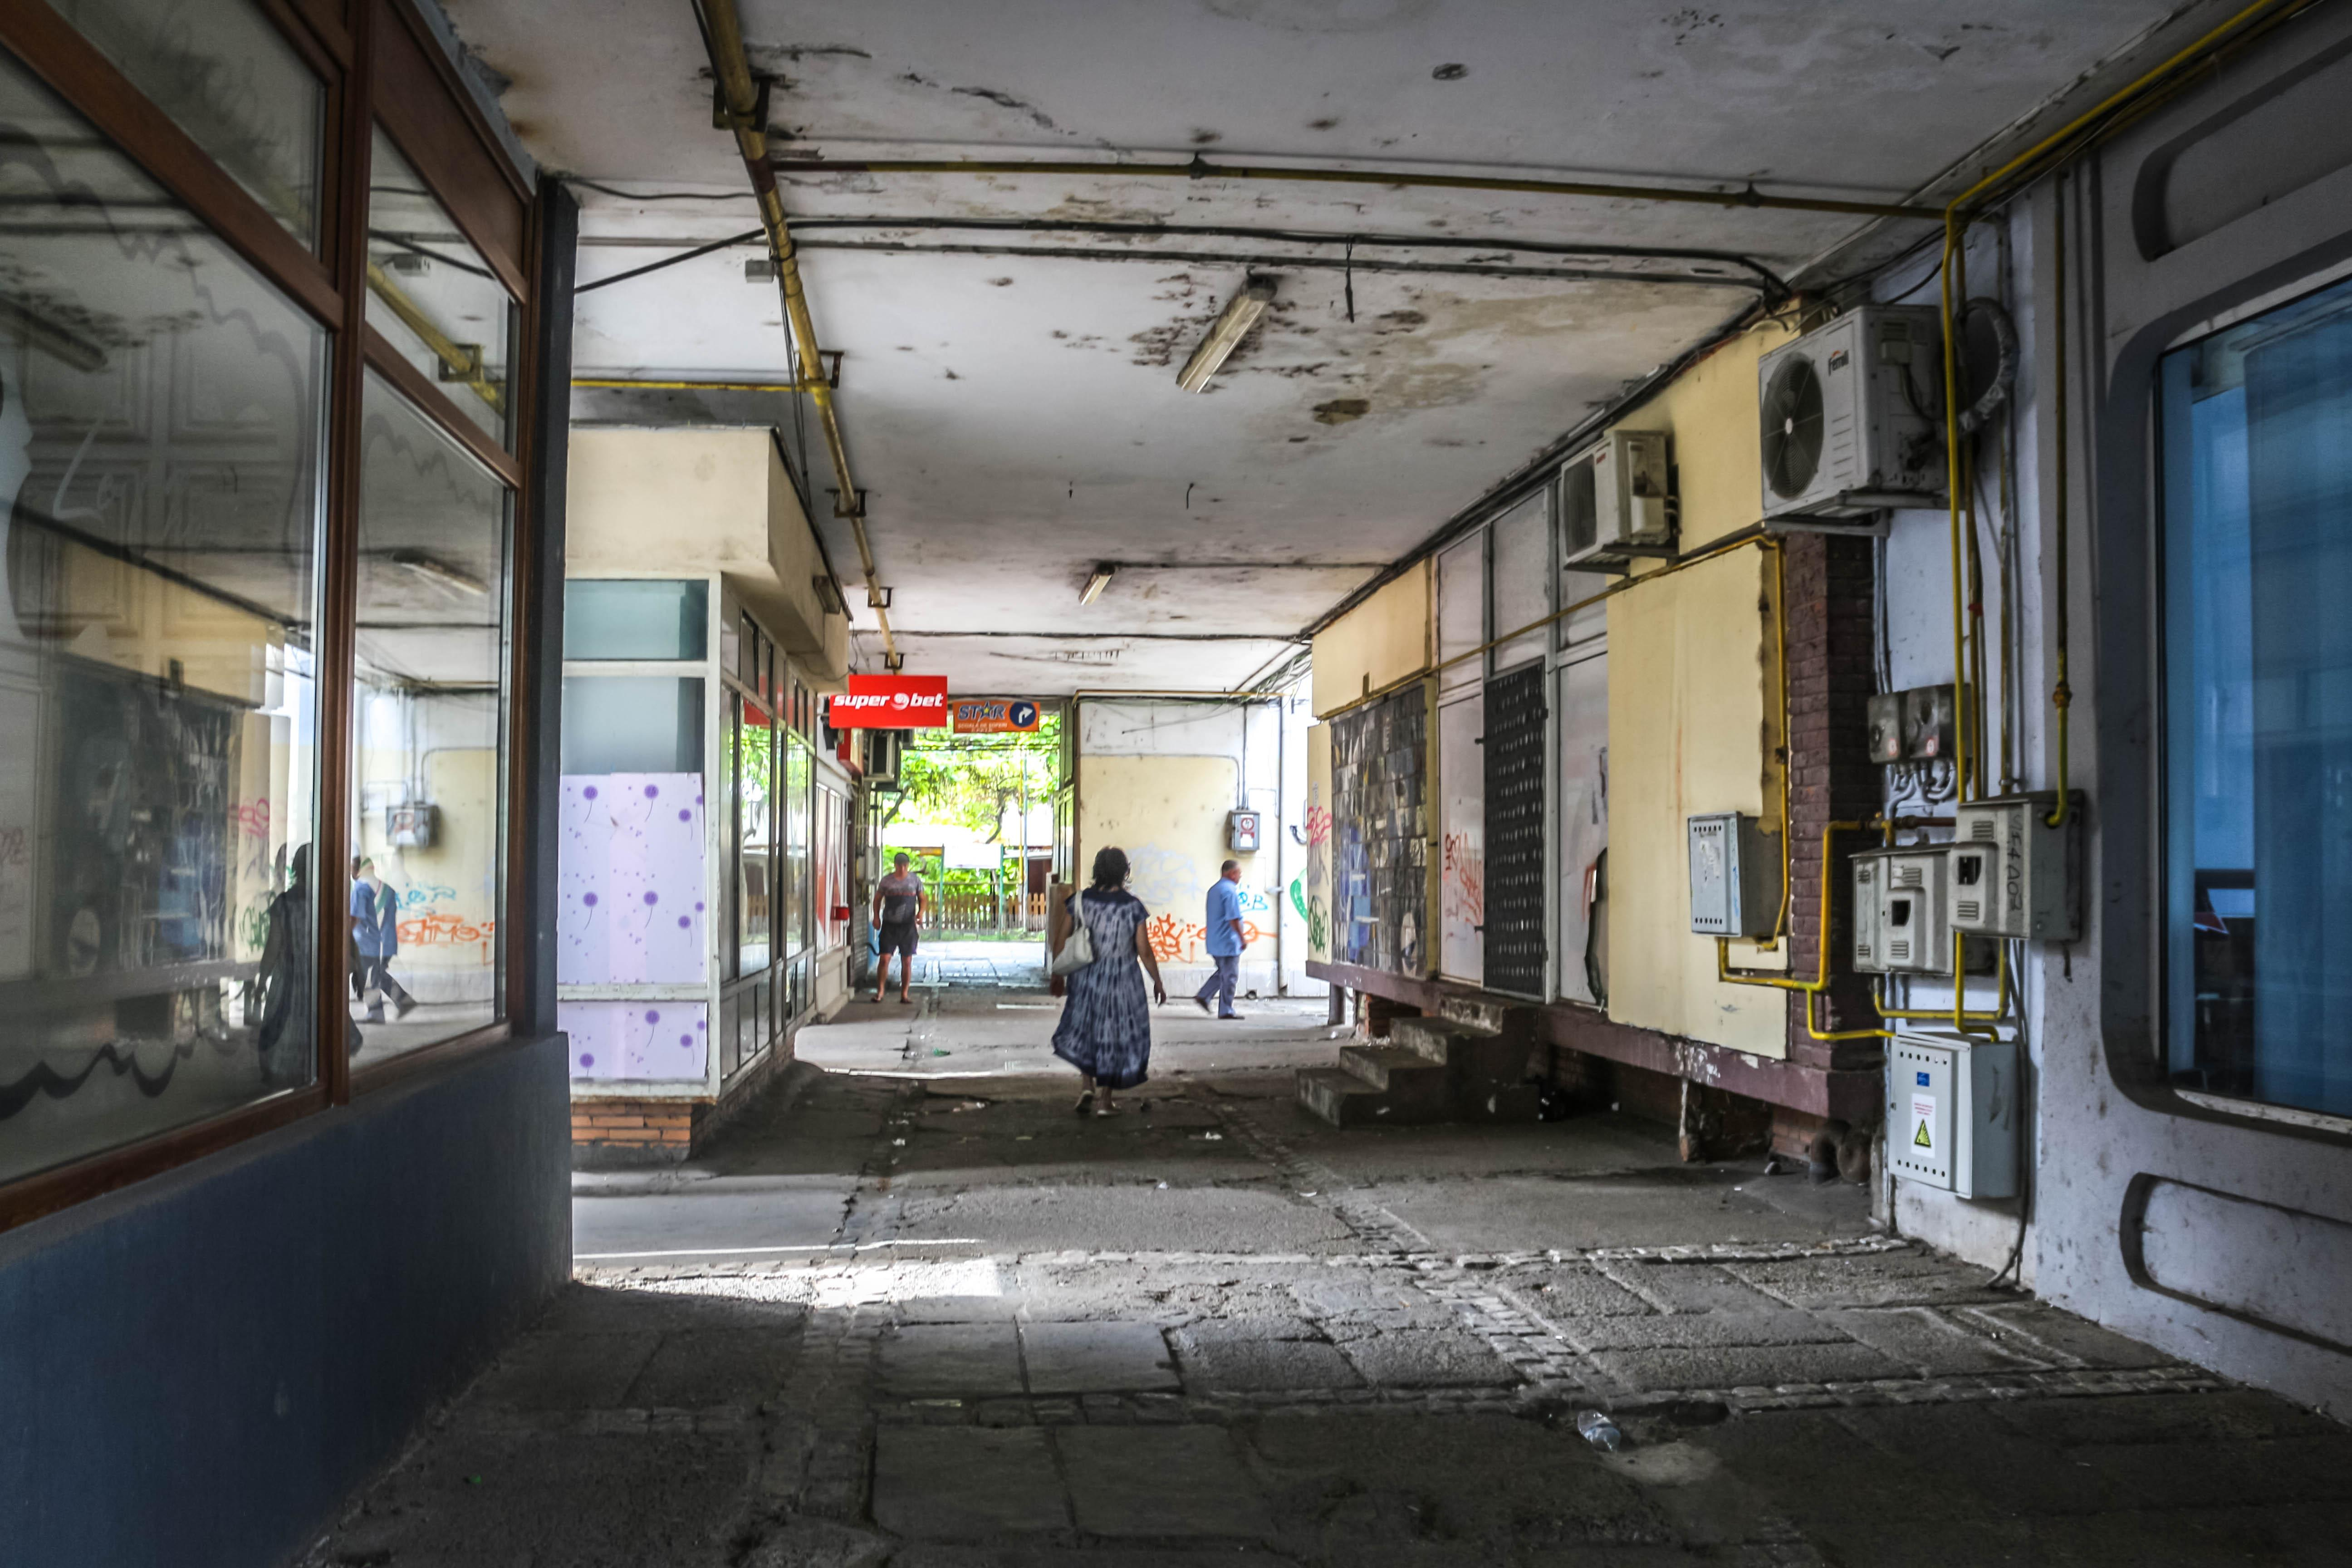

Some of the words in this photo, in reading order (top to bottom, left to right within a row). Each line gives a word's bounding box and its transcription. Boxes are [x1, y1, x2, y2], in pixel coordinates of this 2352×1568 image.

[833, 695, 891, 710] super
[910, 692, 944, 707] bet
[958, 701, 1006, 722] STAR
